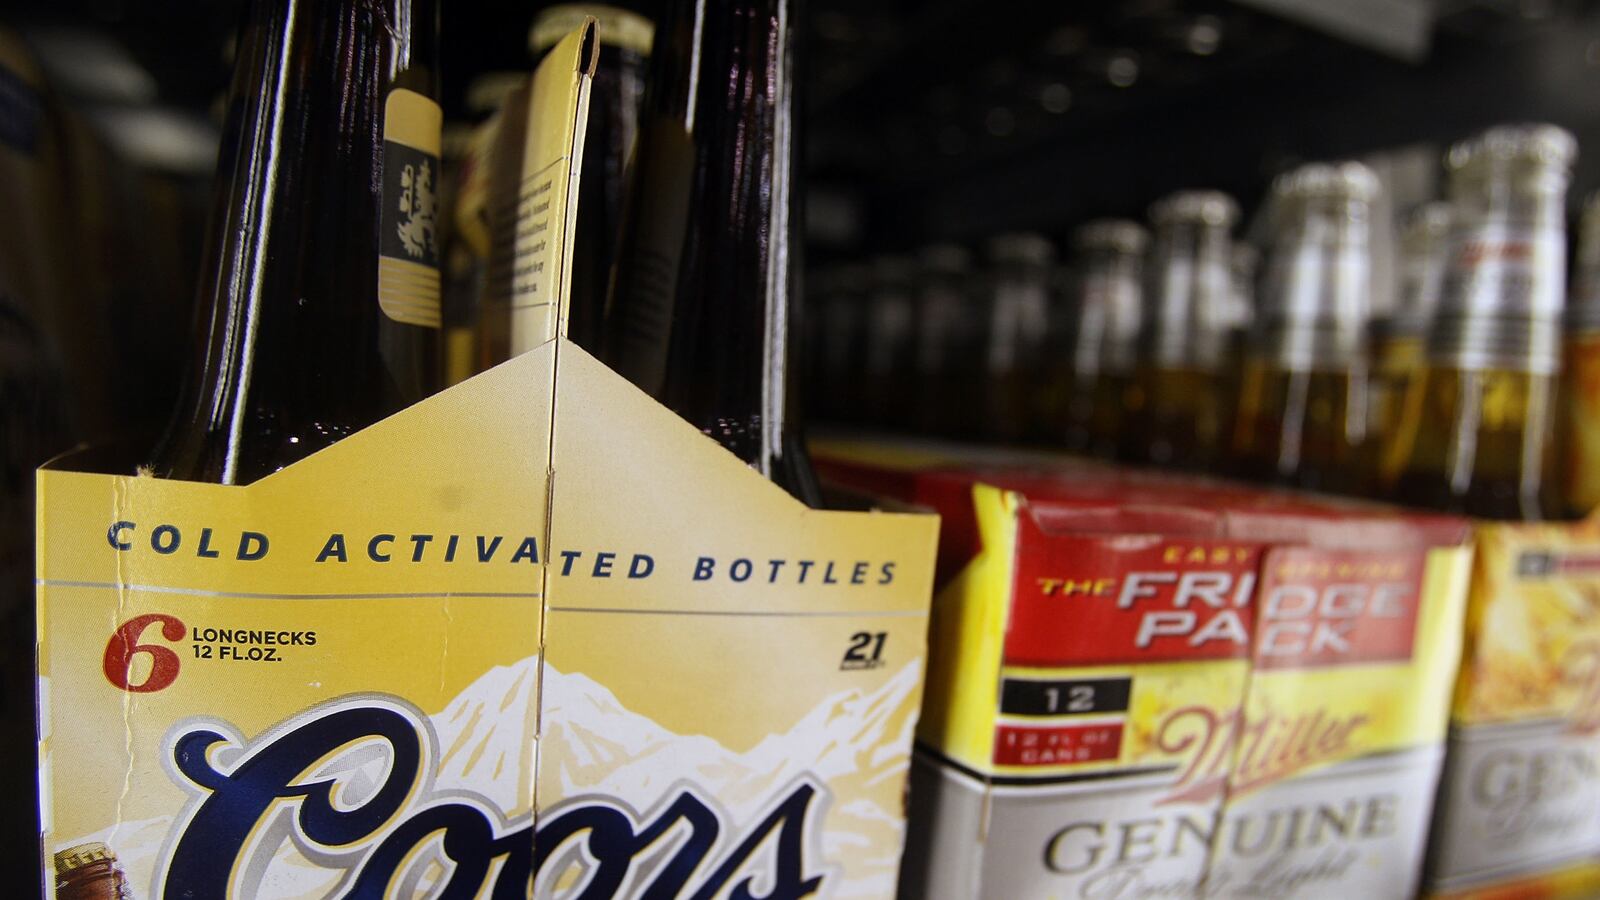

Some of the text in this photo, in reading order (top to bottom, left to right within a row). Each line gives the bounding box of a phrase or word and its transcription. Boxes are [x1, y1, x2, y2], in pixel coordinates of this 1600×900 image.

[107, 520, 896, 585] COLD ACTIVATED BOTTLES
[1163, 545, 1253, 565] EASY
[1036, 570, 1416, 621] THE FRIDGE
[103, 613, 187, 693] 6
[193, 627, 317, 646] LONGNECKS
[193, 645, 213, 659] 12
[843, 631, 888, 661] 21
[1135, 610, 1360, 657] PACK
[1045, 684, 1097, 713] 12
[1020, 746, 1091, 763] CANS
[1155, 705, 1373, 798] Miller
[162, 700, 825, 900] Coors
[1042, 793, 1398, 876] GENUINE
